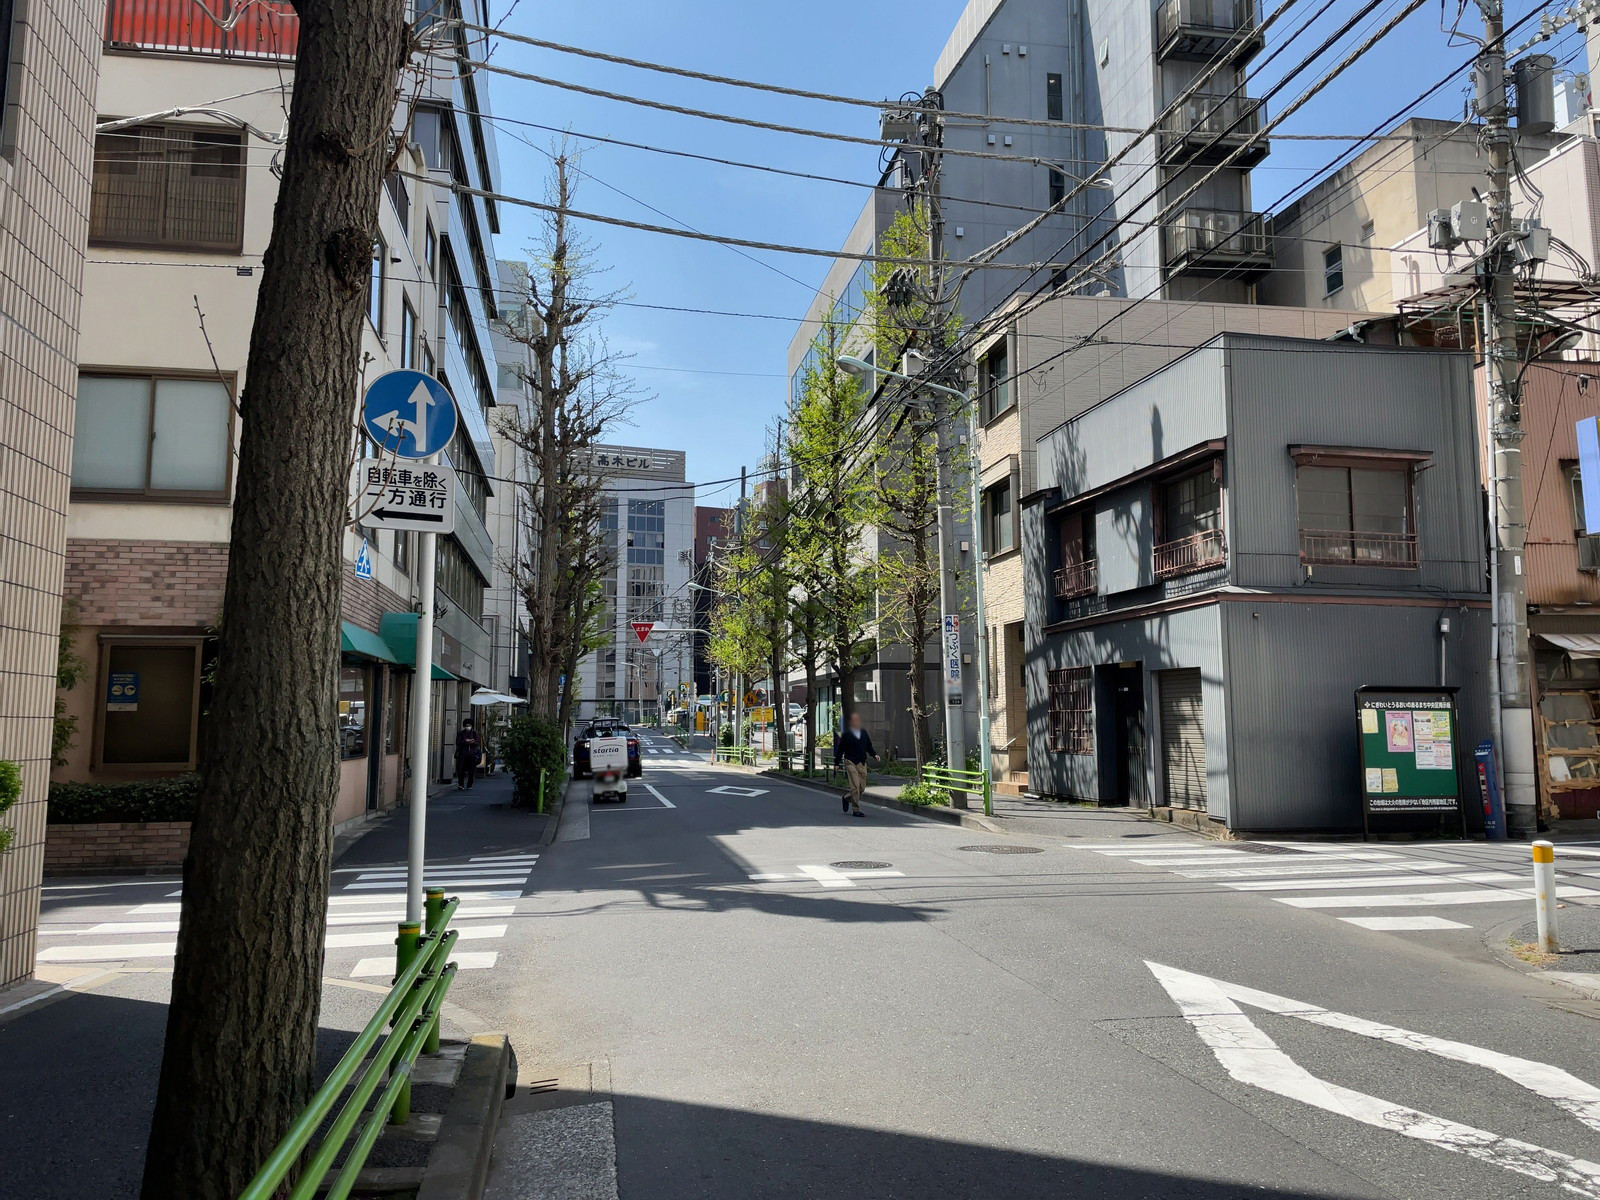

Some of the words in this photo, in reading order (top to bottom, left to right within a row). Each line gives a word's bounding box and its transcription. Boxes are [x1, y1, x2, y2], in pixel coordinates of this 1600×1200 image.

[597, 454, 650, 469] 高木ビル
[367, 466, 447, 490] 自転車を除く
[367, 487, 447, 509] 一方通行
